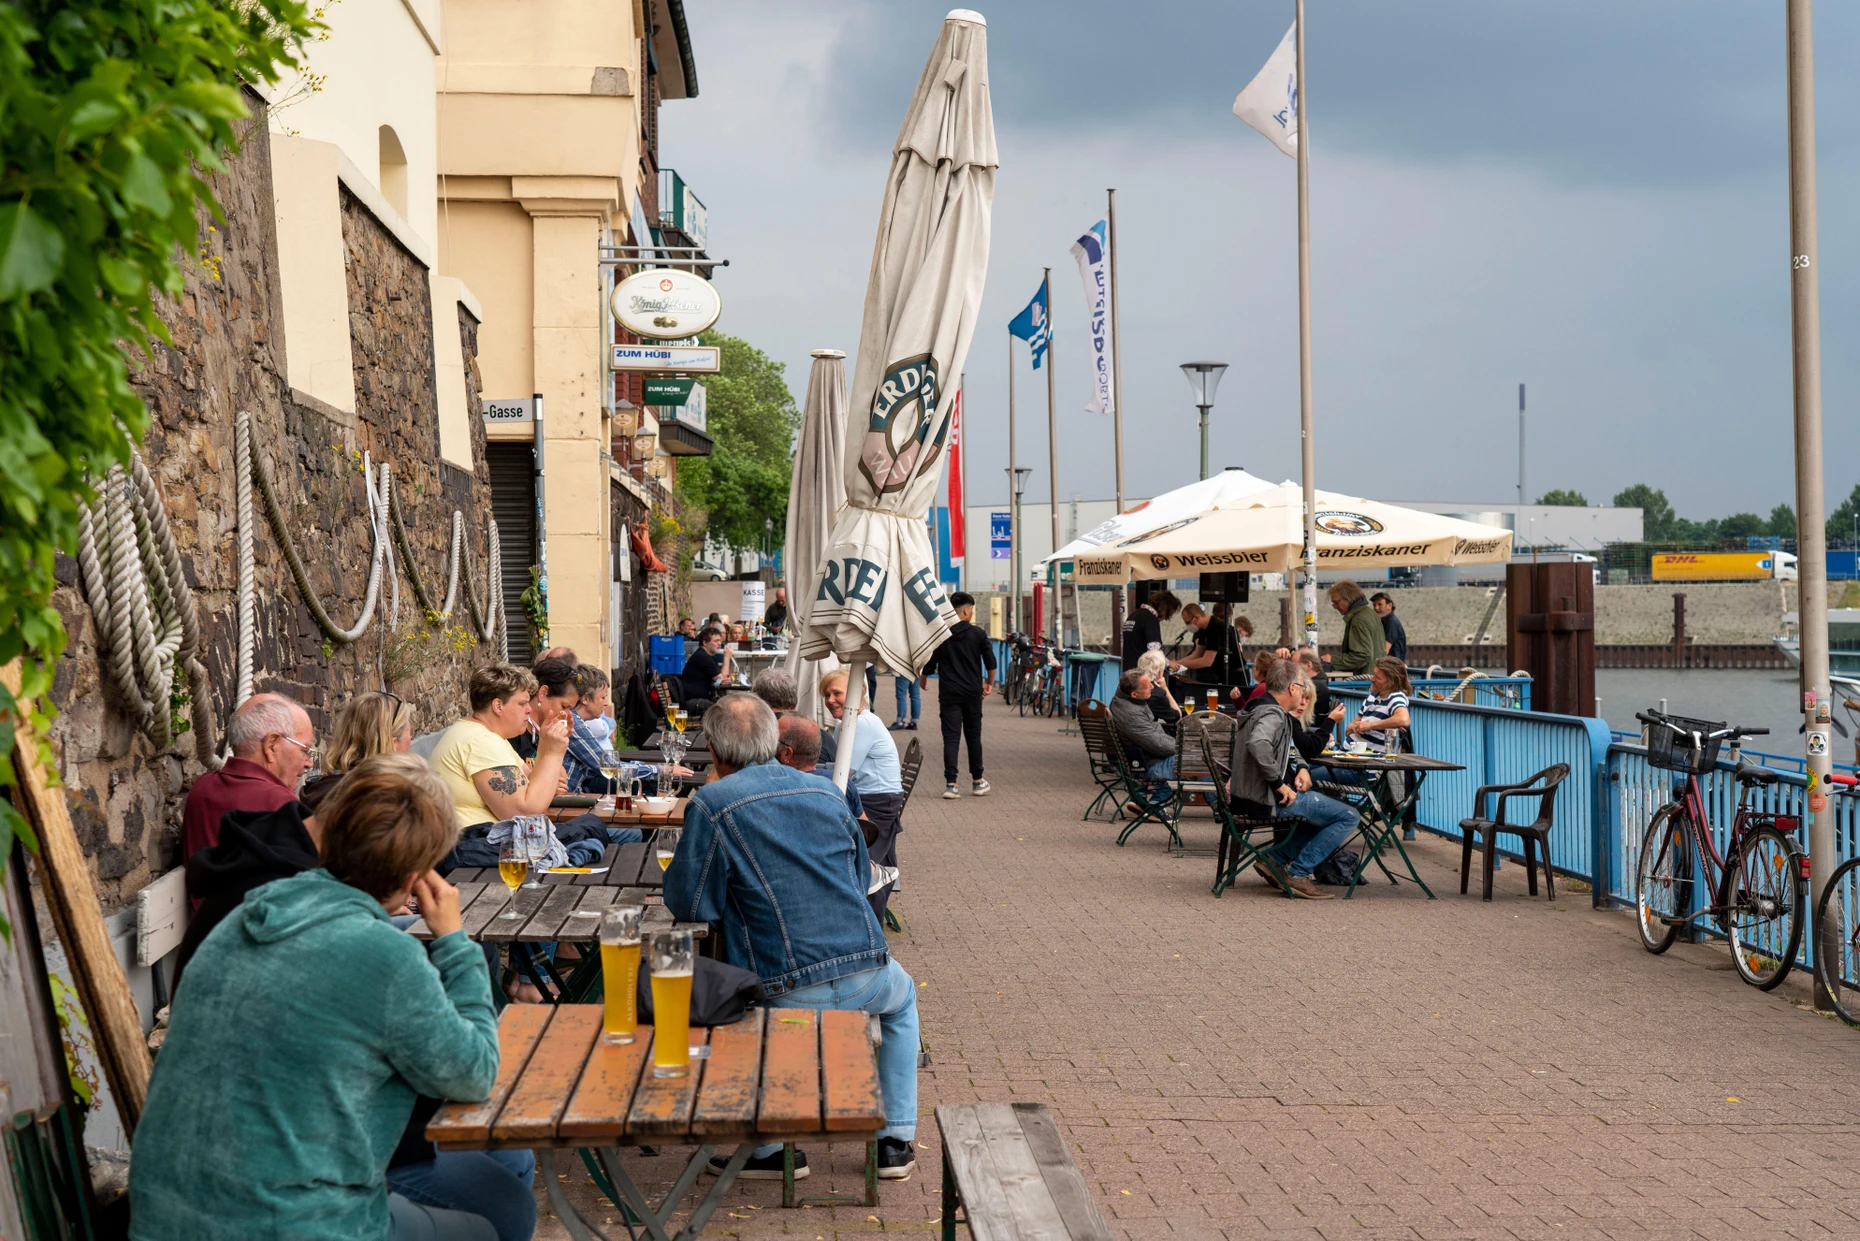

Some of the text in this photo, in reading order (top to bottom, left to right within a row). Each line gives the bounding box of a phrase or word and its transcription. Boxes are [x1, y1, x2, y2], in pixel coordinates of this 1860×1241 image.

[1793, 254, 1810, 270] 23
[616, 350, 671, 359] ZUM HÜBI
[1079, 558, 1122, 576] Franziskaner
[1174, 551, 1268, 567] Weissbier
[1664, 556, 1698, 564] DHL
[627, 962, 635, 1022] ALKOHOLFREI
